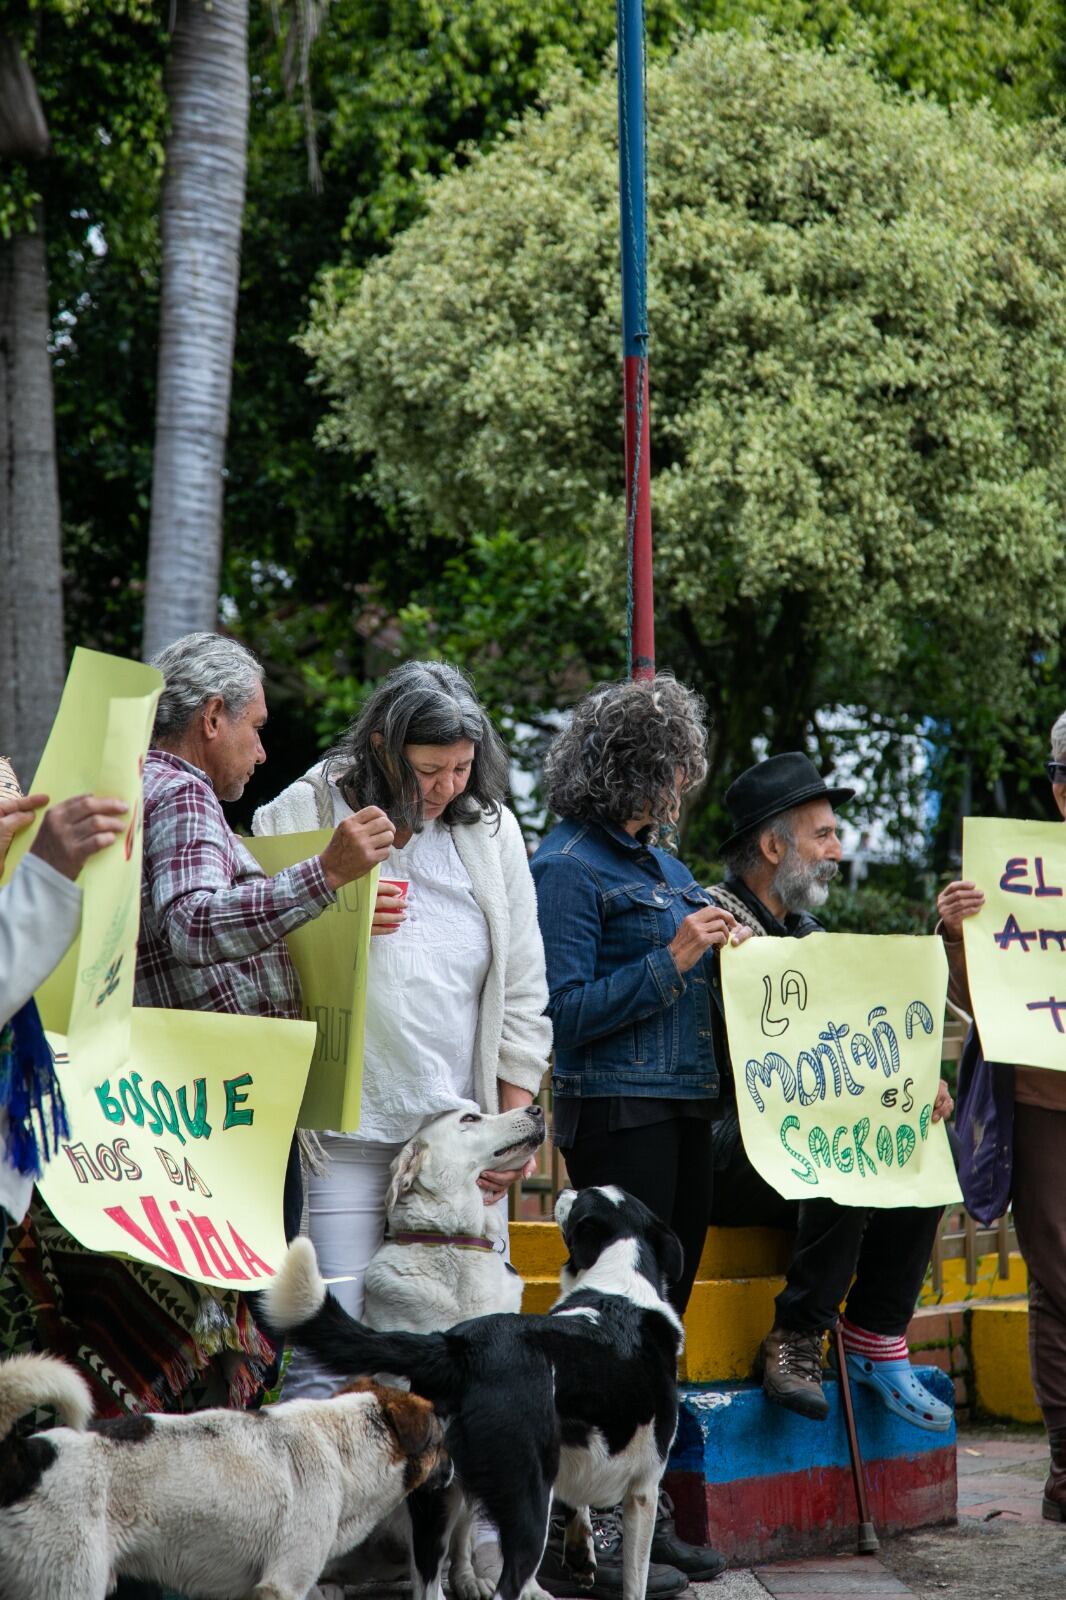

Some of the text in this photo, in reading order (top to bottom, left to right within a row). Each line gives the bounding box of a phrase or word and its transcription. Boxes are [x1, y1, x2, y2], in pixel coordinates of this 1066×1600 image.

[1000, 857, 1063, 897] EL
[761, 969, 807, 1037] LA
[95, 1070, 254, 1145] BOSQUE
[155, 1147, 212, 1198] DA
